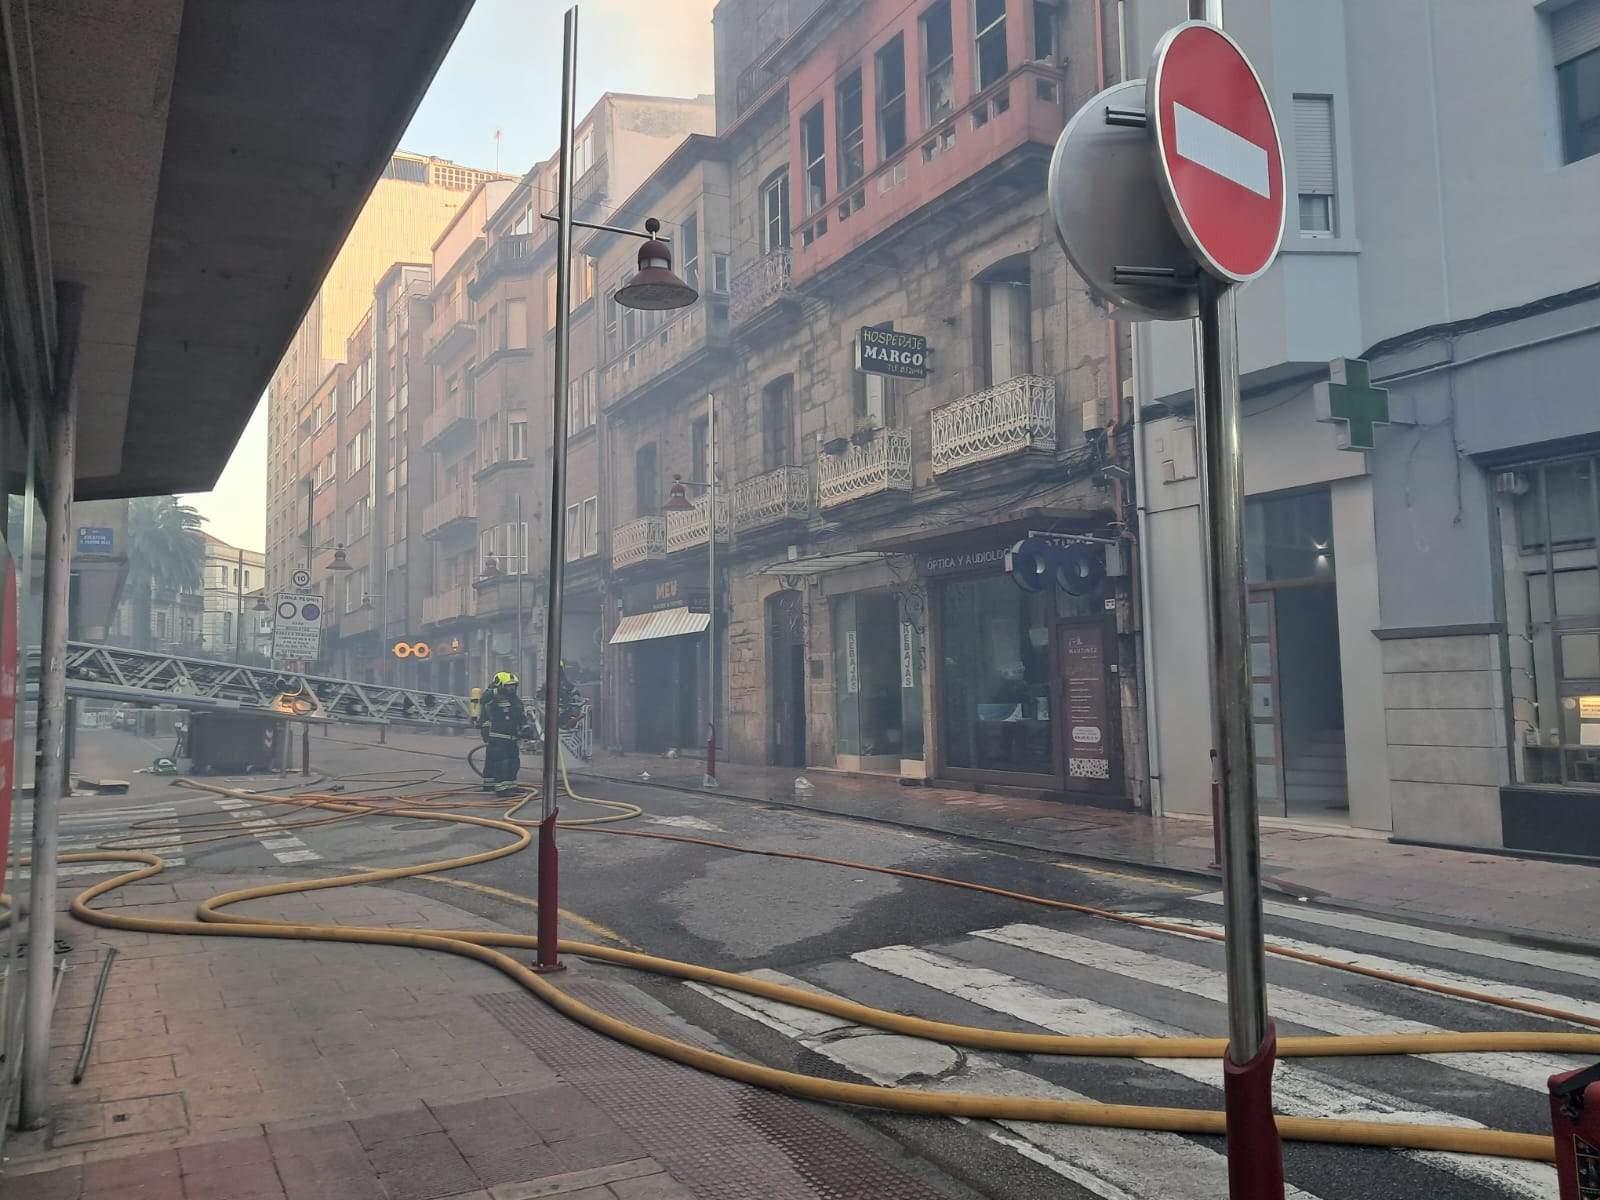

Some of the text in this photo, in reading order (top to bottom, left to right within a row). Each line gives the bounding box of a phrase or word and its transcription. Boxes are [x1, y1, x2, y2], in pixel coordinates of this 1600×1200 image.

[864, 330, 924, 350] HOSPEDAJE
[864, 345, 923, 366] MARGO
[957, 555, 964, 566] Y
[903, 623, 912, 687] REBAJAS
